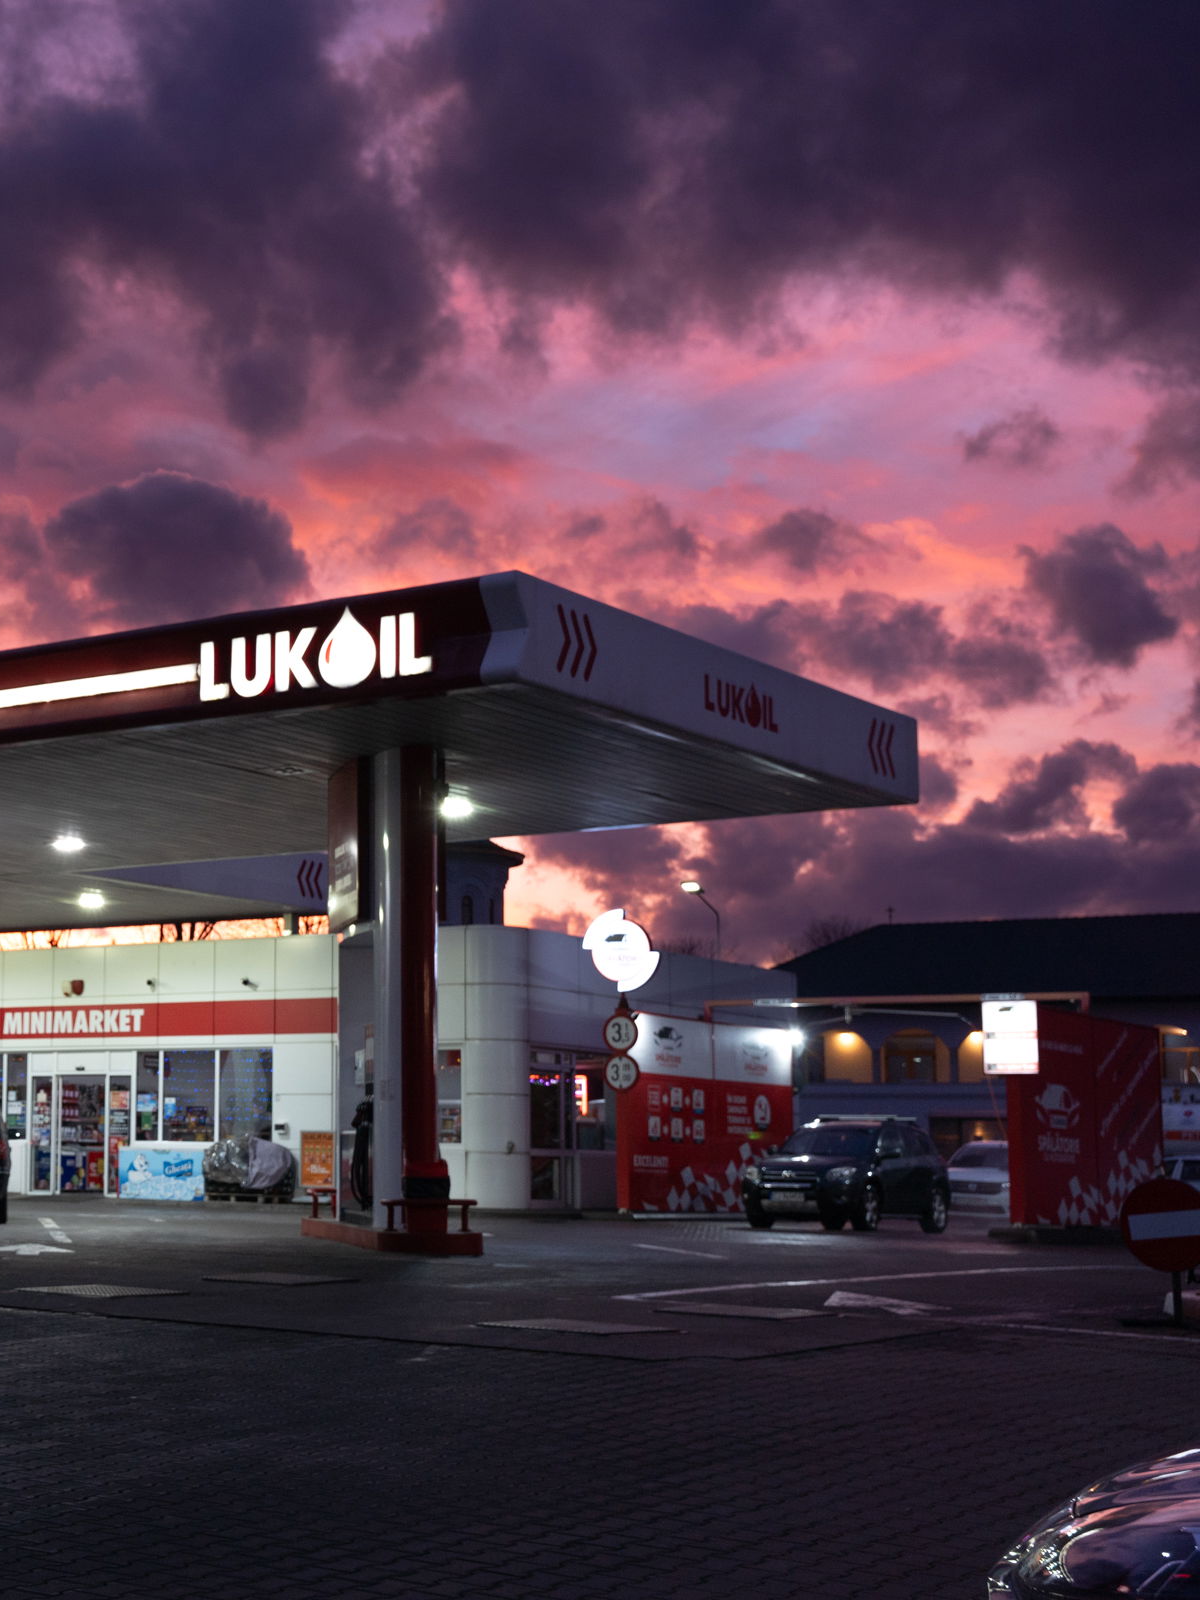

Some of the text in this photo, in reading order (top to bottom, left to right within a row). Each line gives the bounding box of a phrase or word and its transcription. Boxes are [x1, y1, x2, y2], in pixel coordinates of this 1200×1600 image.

[196, 607, 432, 702] LUKOIL
[704, 674, 780, 734] LUKOIL
[2, 1008, 145, 1036] MINIMARKET
